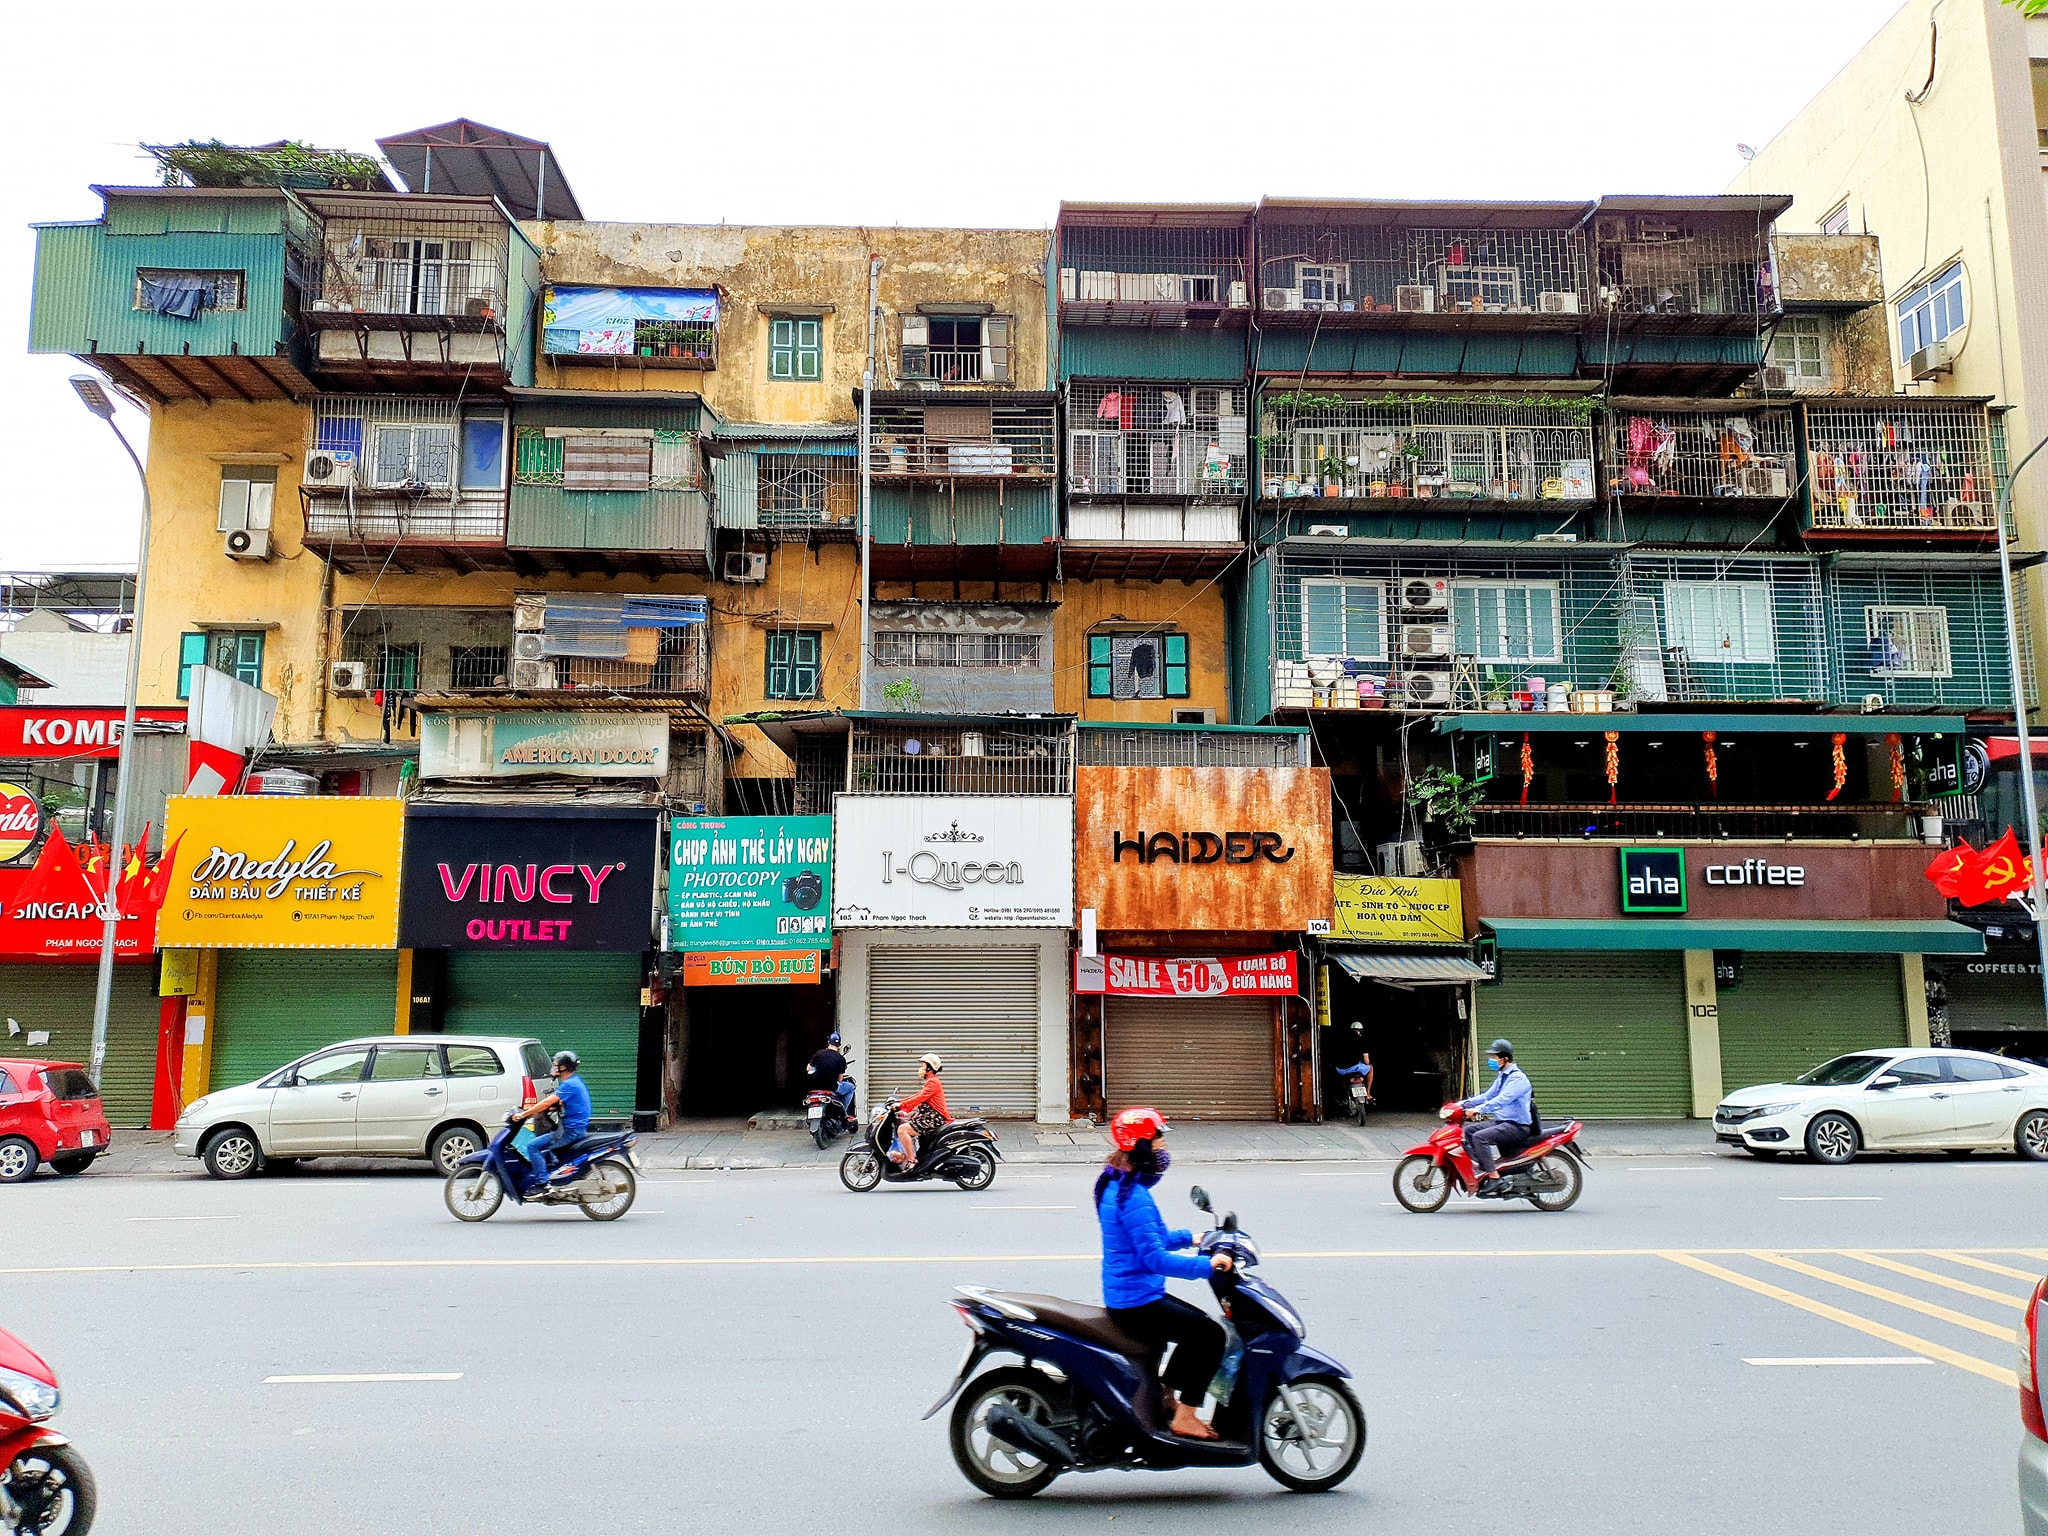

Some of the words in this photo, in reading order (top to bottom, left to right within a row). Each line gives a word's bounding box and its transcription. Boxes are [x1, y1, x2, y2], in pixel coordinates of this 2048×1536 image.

[501, 749, 596, 764] AMERICAN
[599, 749, 655, 764] DOOR
[1477, 749, 1490, 770] aha
[1929, 757, 1957, 782] aha
[676, 820, 697, 829] CÔNG
[700, 821, 726, 829] TRUNG
[674, 839, 708, 871] CHỤP
[711, 830, 737, 865] ẢNH
[741, 829, 765, 865] THẺ
[769, 825, 794, 864] LẤY
[797, 837, 829, 864] NGAY
[191, 839, 382, 899] Medyla
[882, 851, 1024, 891] I-Queen
[1630, 866, 1679, 894] aha
[1705, 858, 1805, 886] coffee
[437, 863, 615, 903] VINCY
[683, 870, 781, 888] PHOTOCOPY
[189, 881, 225, 899] ĐẦM
[229, 881, 261, 899] BẦU
[295, 881, 337, 900] THIẾT
[341, 881, 365, 900] KẾ
[1360, 884, 1386, 896] Đức
[1334, 900, 1351, 908] AFE
[1362, 901, 1384, 910] SINH
[1357, 912, 1377, 921] HOA
[466, 918, 572, 941] OUTLET
[1310, 922, 1328, 932] 104
[45, 939, 73, 948] PHẠM
[76, 939, 103, 949] NGỌC
[114, 939, 138, 948] HẠCH
[710, 956, 747, 975] BÚN
[751, 955, 775, 974] BÒ
[779, 952, 816, 974] HUẾ
[1270, 956, 1287, 973] BỘ
[1717, 960, 1735, 978] aha
[1109, 957, 1161, 989] SALE
[1177, 963, 1223, 993] 50%
[1232, 974, 1257, 989] CỬA
[1260, 973, 1293, 989] HÀNG
[1690, 1004, 1718, 1018] 102
